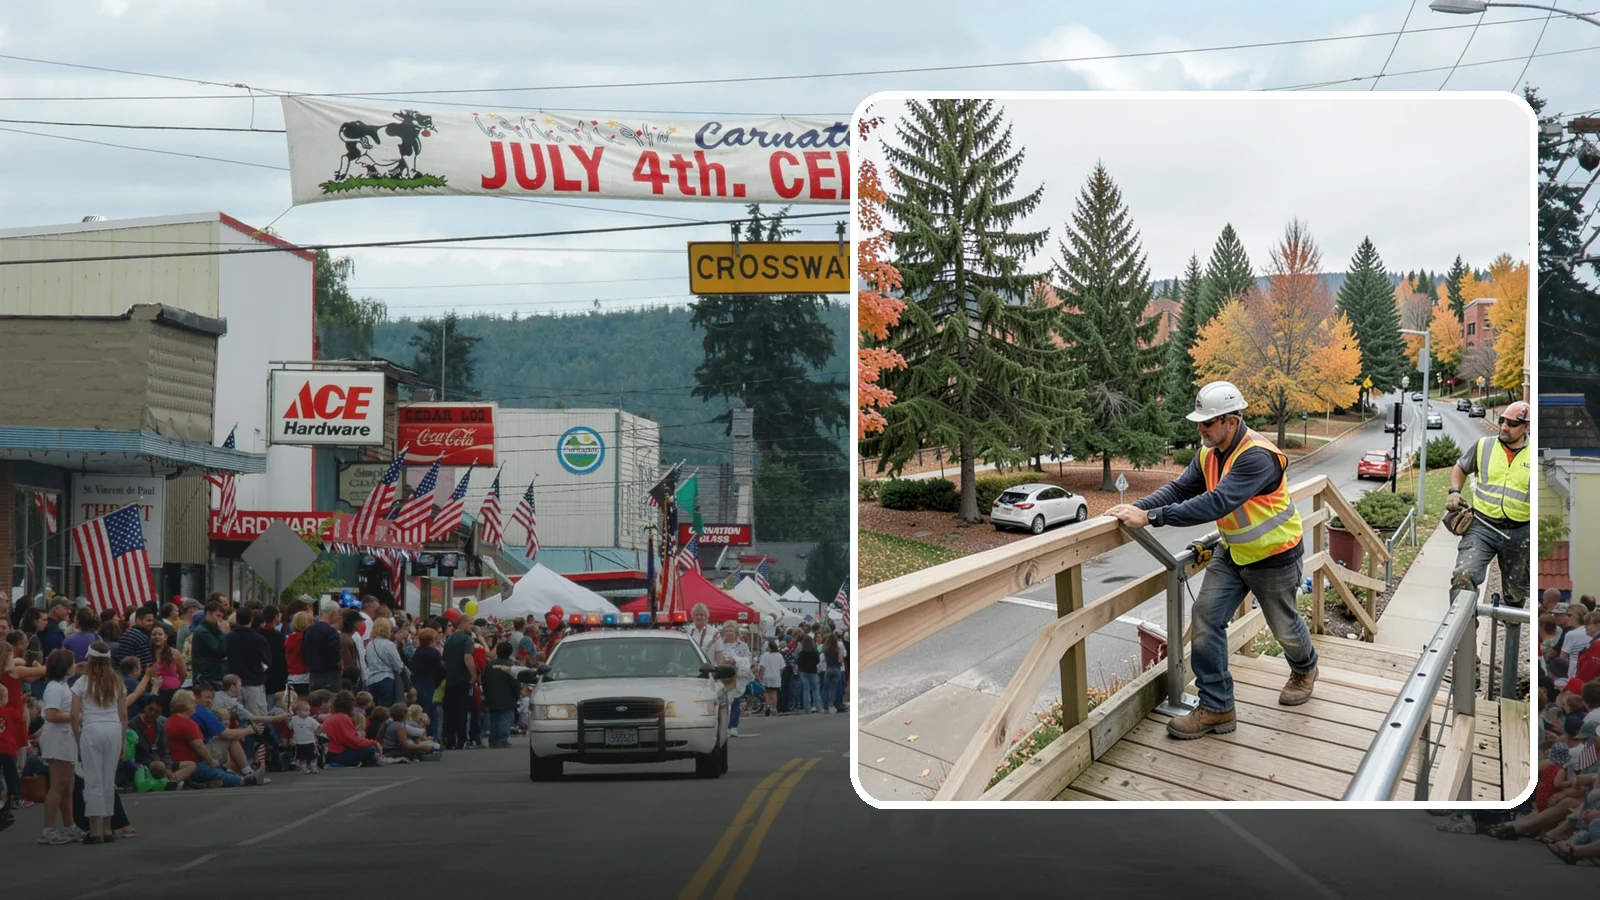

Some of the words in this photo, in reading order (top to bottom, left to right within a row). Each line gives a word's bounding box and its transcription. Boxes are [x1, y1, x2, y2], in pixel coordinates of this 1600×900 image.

[480, 141, 606, 193] JULY
[632, 149, 747, 198] 4th.
[697, 254, 851, 280] CROSSWA
[282, 380, 374, 420] ACE
[405, 409, 452, 421] CEDAR
[283, 420, 371, 437] Hardware
[416, 427, 477, 447] Coca-Cola
[353, 466, 385, 480] Simpl
[83, 485, 93, 494] St.
[95, 485, 125, 495] Vincent
[126, 486, 136, 495] de
[137, 486, 155, 496] Paul
[212, 515, 331, 536] HARDARE
[688, 526, 741, 536] CRNATION
[699, 535, 730, 543] GLASS
